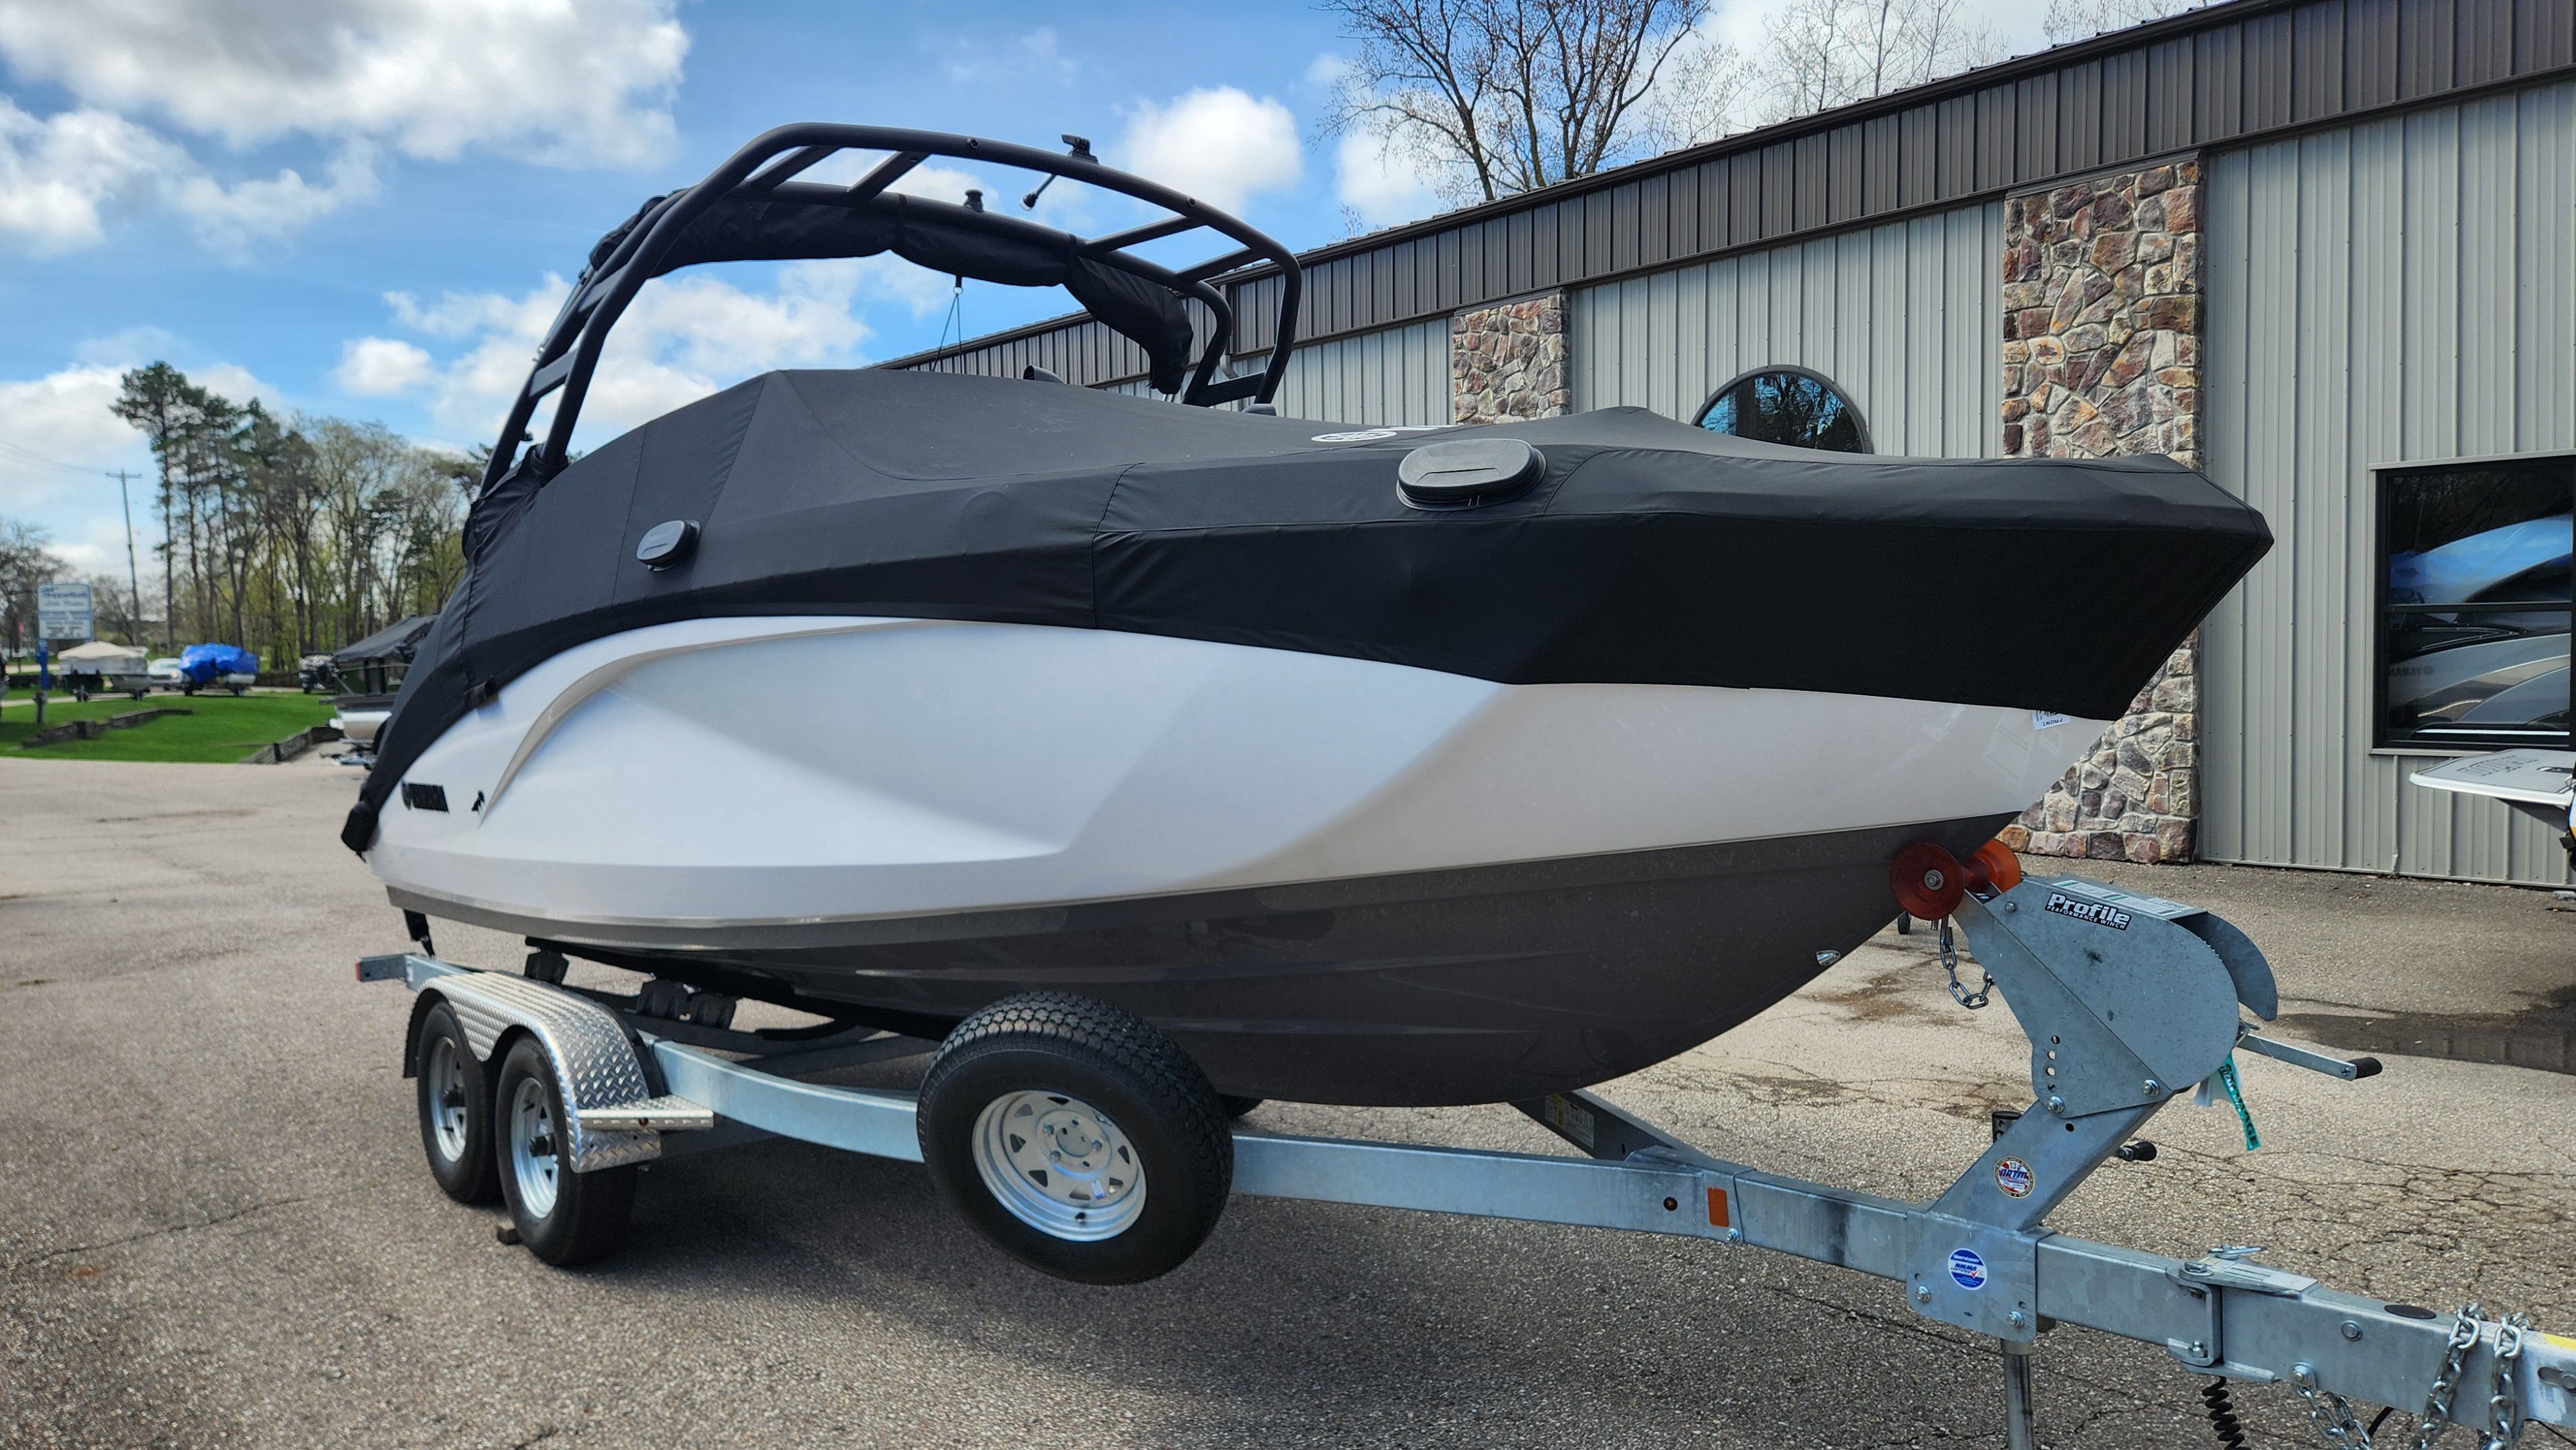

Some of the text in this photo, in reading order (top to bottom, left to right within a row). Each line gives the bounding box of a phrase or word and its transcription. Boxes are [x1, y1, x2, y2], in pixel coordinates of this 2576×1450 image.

[2047, 906, 2125, 930] PERFORMANCE WINCH
[2048, 893, 2131, 924] Profile
